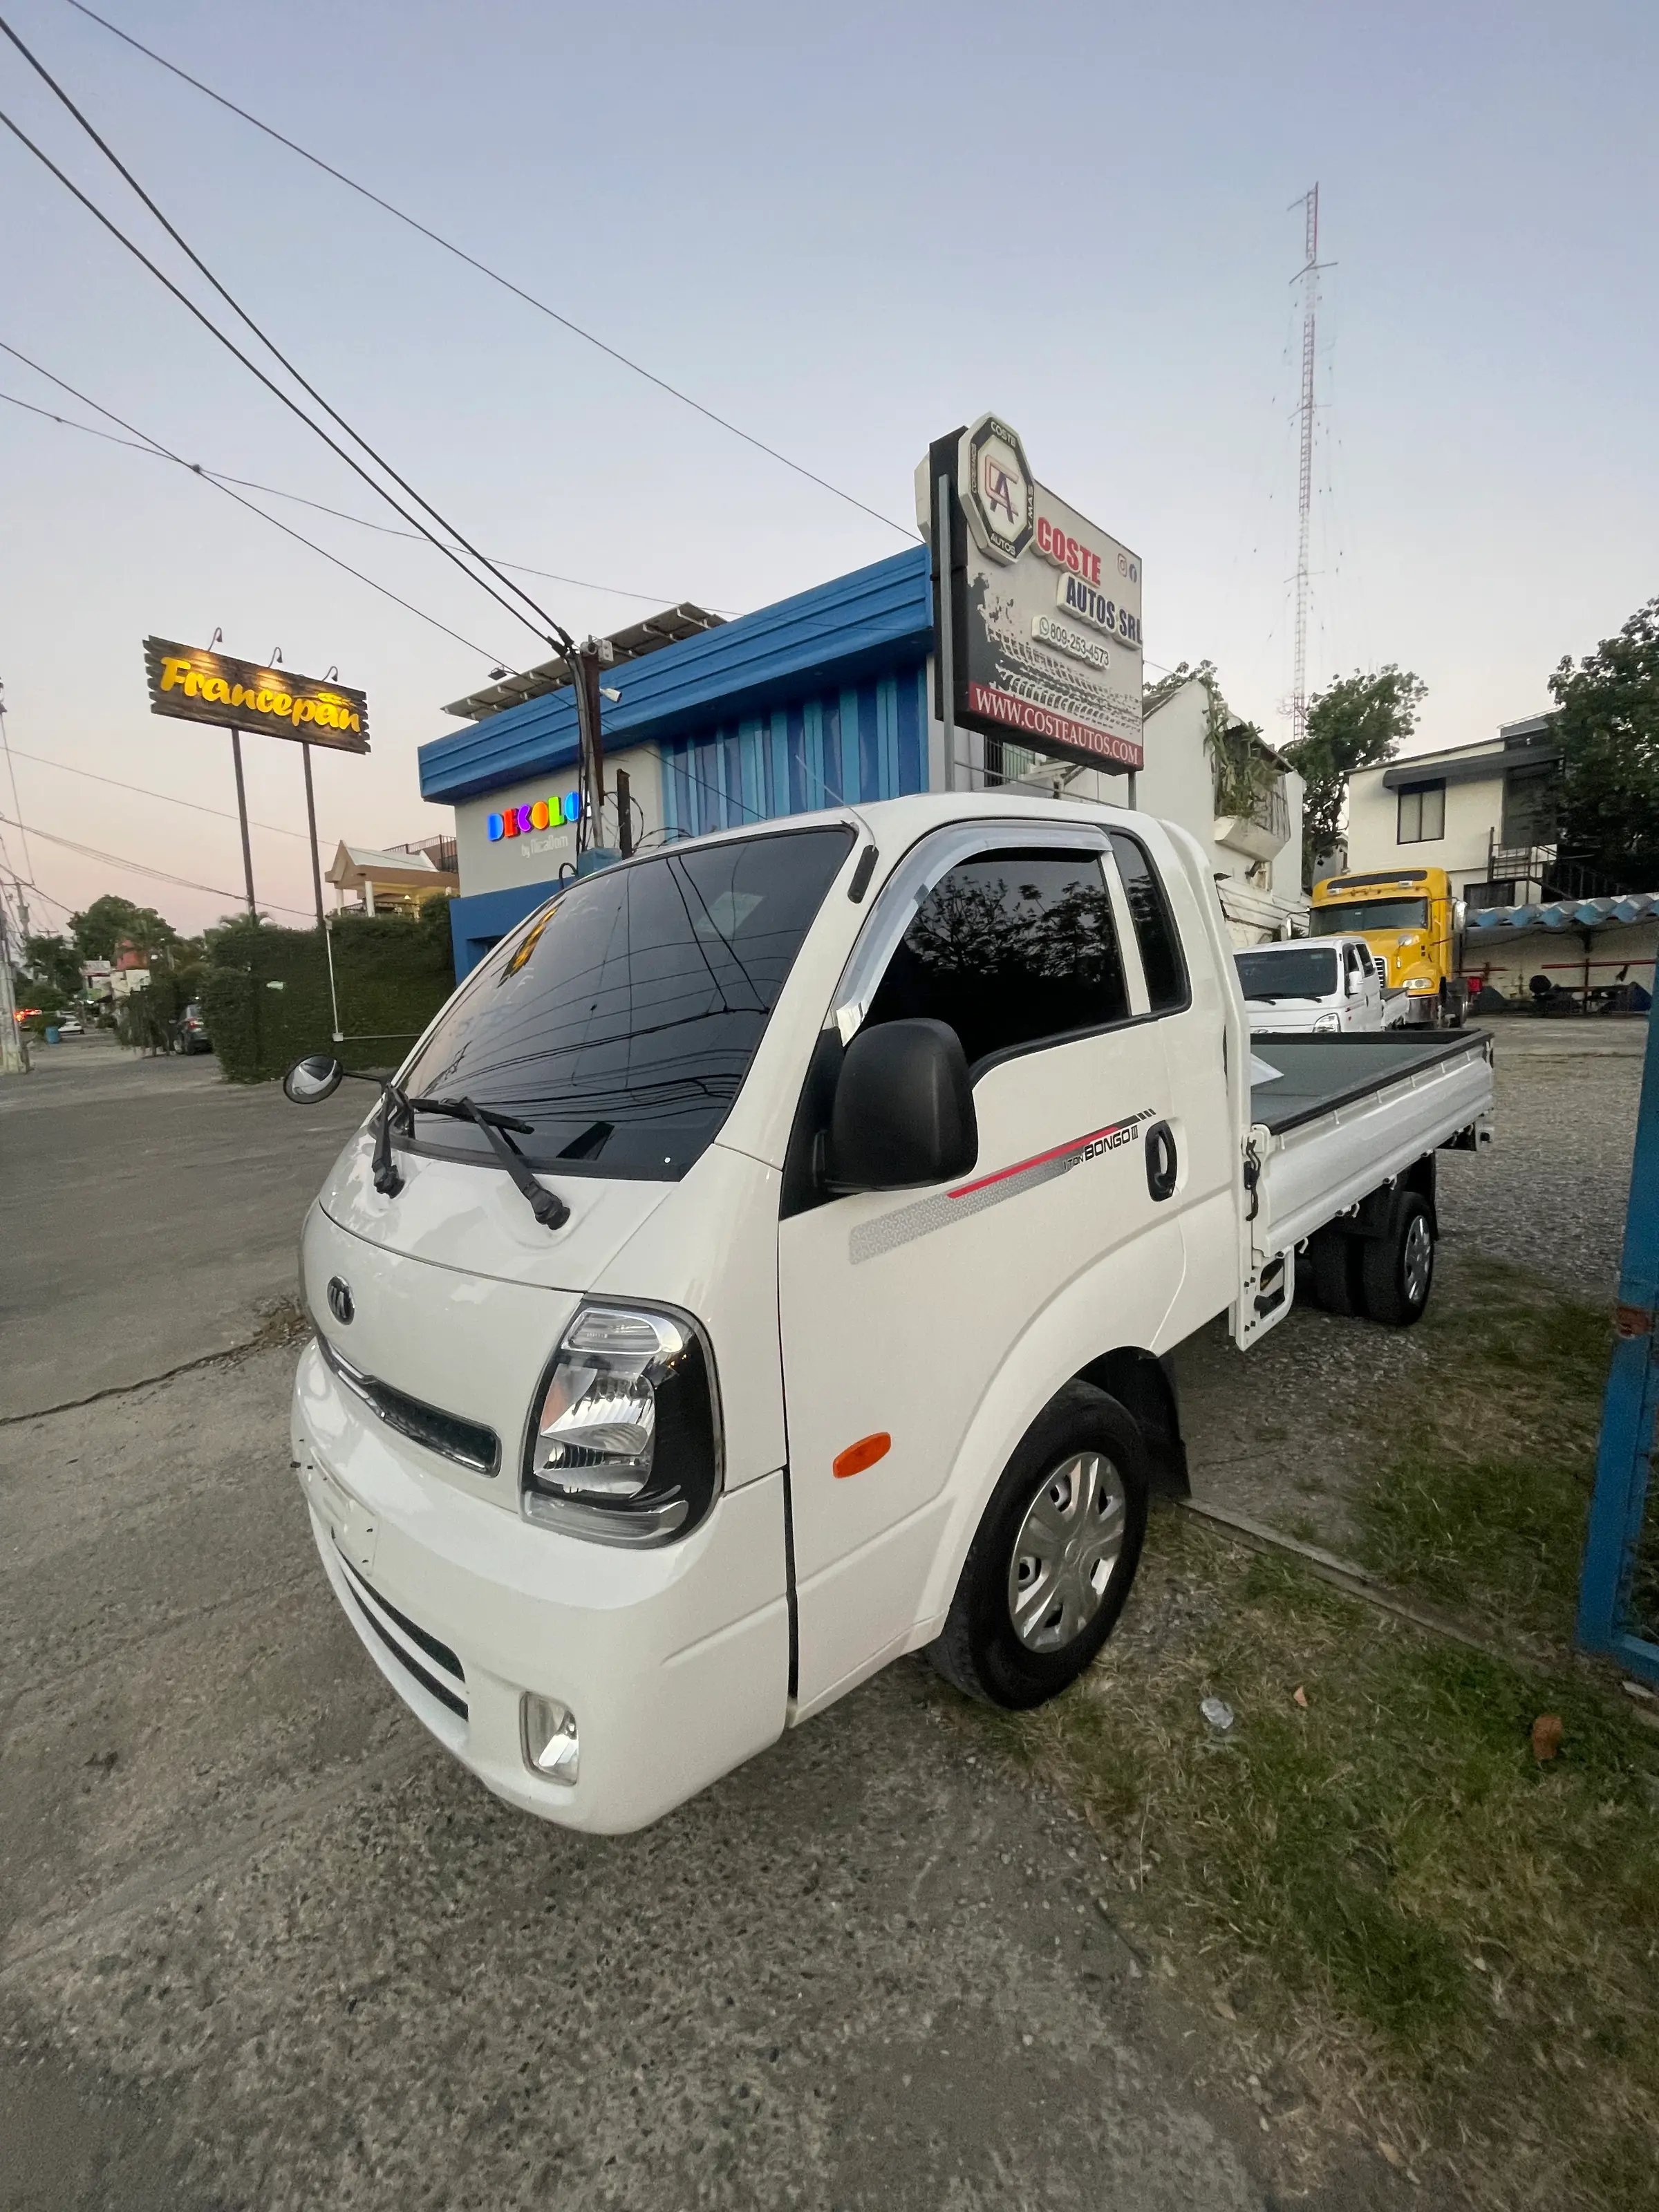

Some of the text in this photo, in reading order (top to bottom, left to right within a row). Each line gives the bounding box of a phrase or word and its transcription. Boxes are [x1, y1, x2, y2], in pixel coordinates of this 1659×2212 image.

[991, 421, 1017, 449] COSTE
[991, 532, 1017, 559] AUTOS
[1038, 516, 1101, 586] COSTE
[1066, 576, 1143, 646] AUTOS SRL
[1050, 623, 1109, 666] 809-253-4573
[160, 656, 361, 733] Francepan
[975, 688, 1139, 765] WWW.COSTEAUTOS.COM
[1084, 1129, 1131, 1161] BONGO
